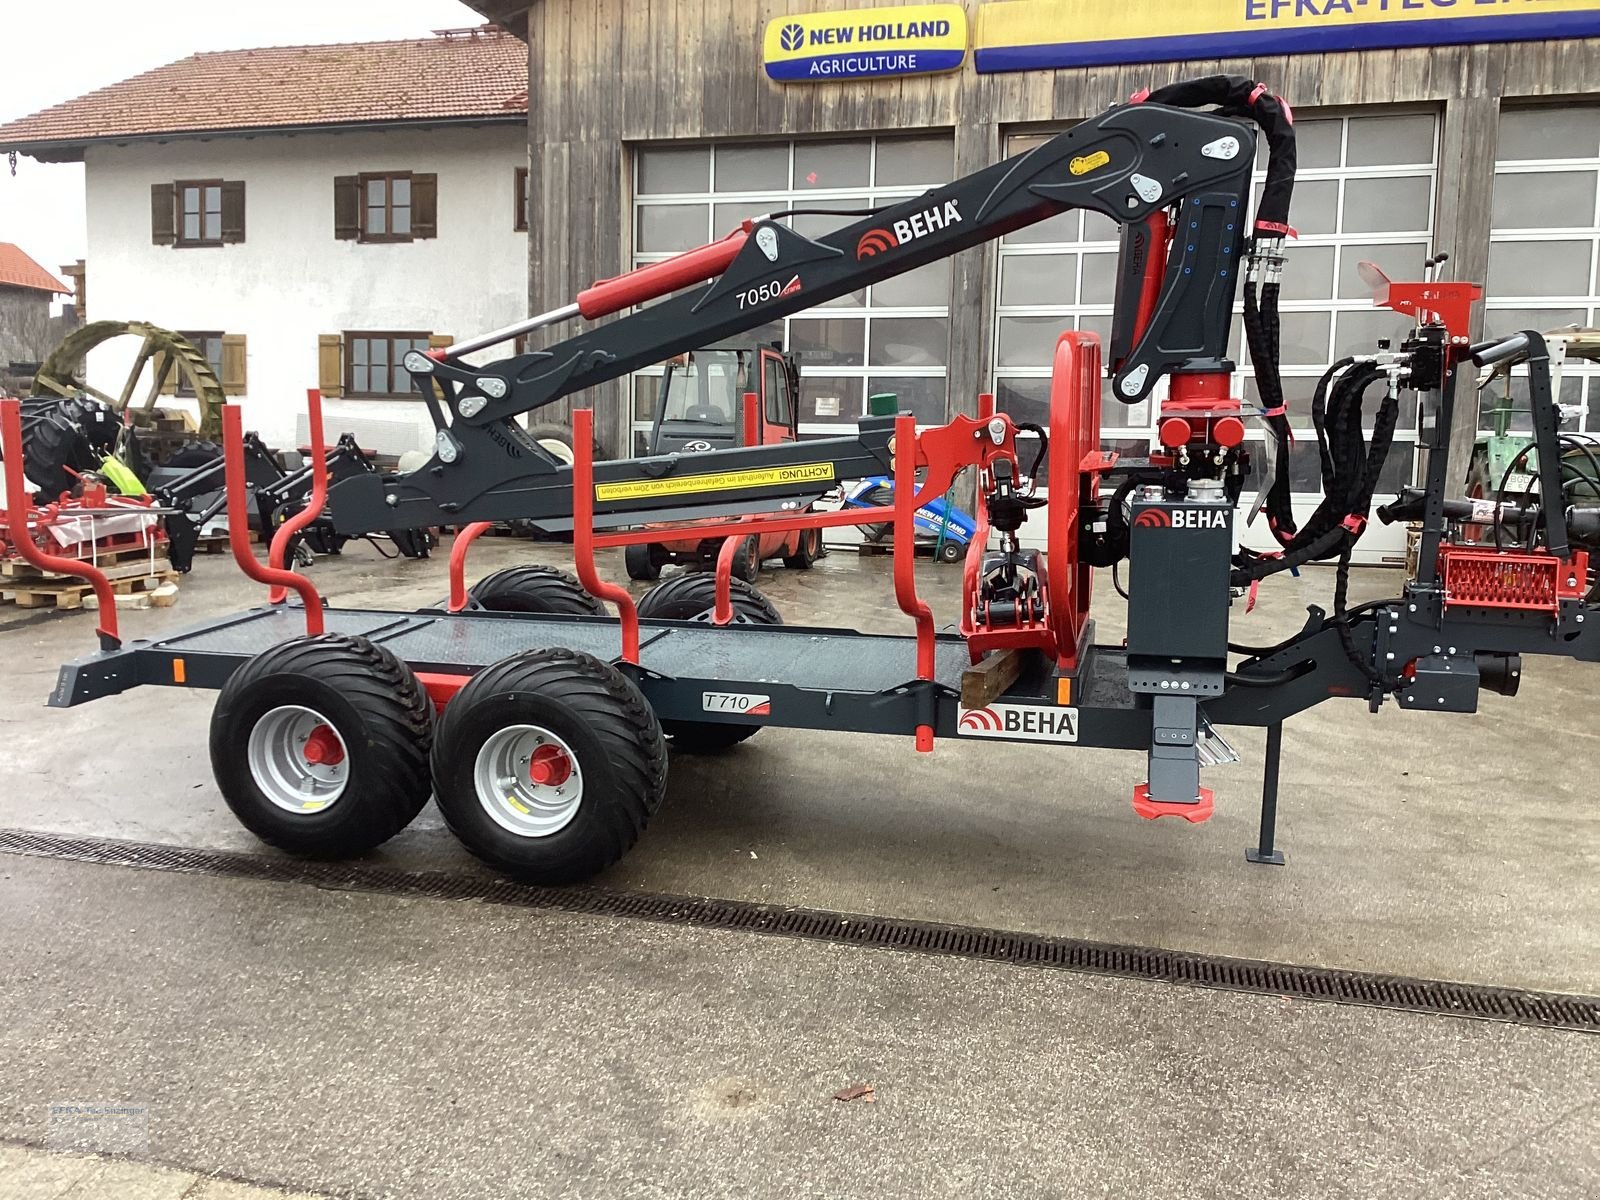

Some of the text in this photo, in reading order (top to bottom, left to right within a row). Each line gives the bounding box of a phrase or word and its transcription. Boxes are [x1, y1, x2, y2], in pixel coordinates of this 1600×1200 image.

[810, 20, 950, 45] NEW HOLLAND
[810, 55, 916, 74] AGRICULTURE
[735, 281, 781, 310] 7050
[737, 472, 774, 482] Aufenthalt
[779, 466, 829, 480] ACHTUNG!
[634, 484, 649, 492] 20m
[666, 477, 726, 489] Gefahrenbereich
[601, 486, 632, 494] verboten
[916, 508, 935, 519] NEW
[705, 694, 749, 709] T 710
